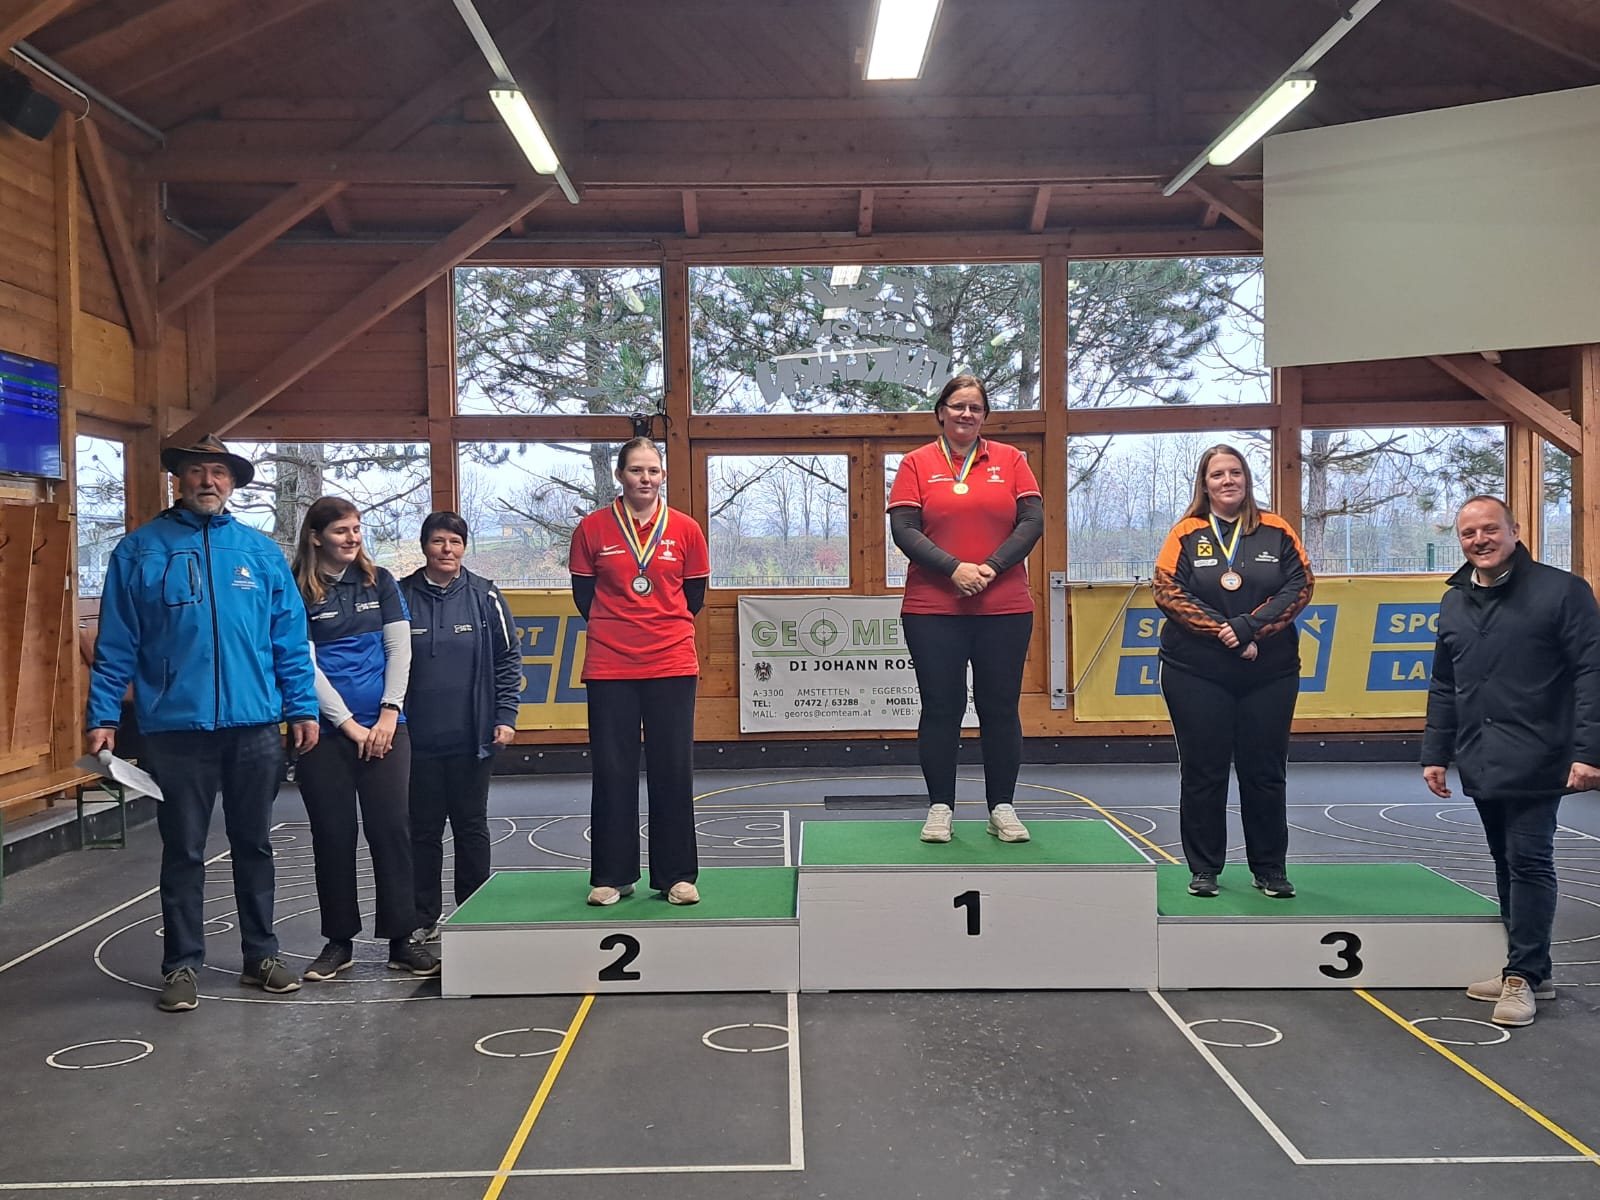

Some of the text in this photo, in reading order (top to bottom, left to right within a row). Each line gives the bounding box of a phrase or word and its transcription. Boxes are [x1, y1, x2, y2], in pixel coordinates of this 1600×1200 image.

[752, 618, 904, 647] GEOME
[789, 660, 807, 672] DI
[814, 659, 878, 671] JOHANN
[752, 700, 771, 708] TEL:
[794, 699, 822, 707] 07472
[831, 698, 859, 706] 63288
[886, 697, 919, 706] MOBIL:
[753, 689, 784, 697] A-3300
[797, 688, 850, 697] AMSTETTEN
[752, 710, 777, 718] MAIL:
[784, 709, 871, 719] georos@comteam.at
[892, 708, 914, 716] WEB:
[953, 890, 981, 936] 1
[599, 933, 641, 981] 2
[1319, 931, 1363, 979] 3
